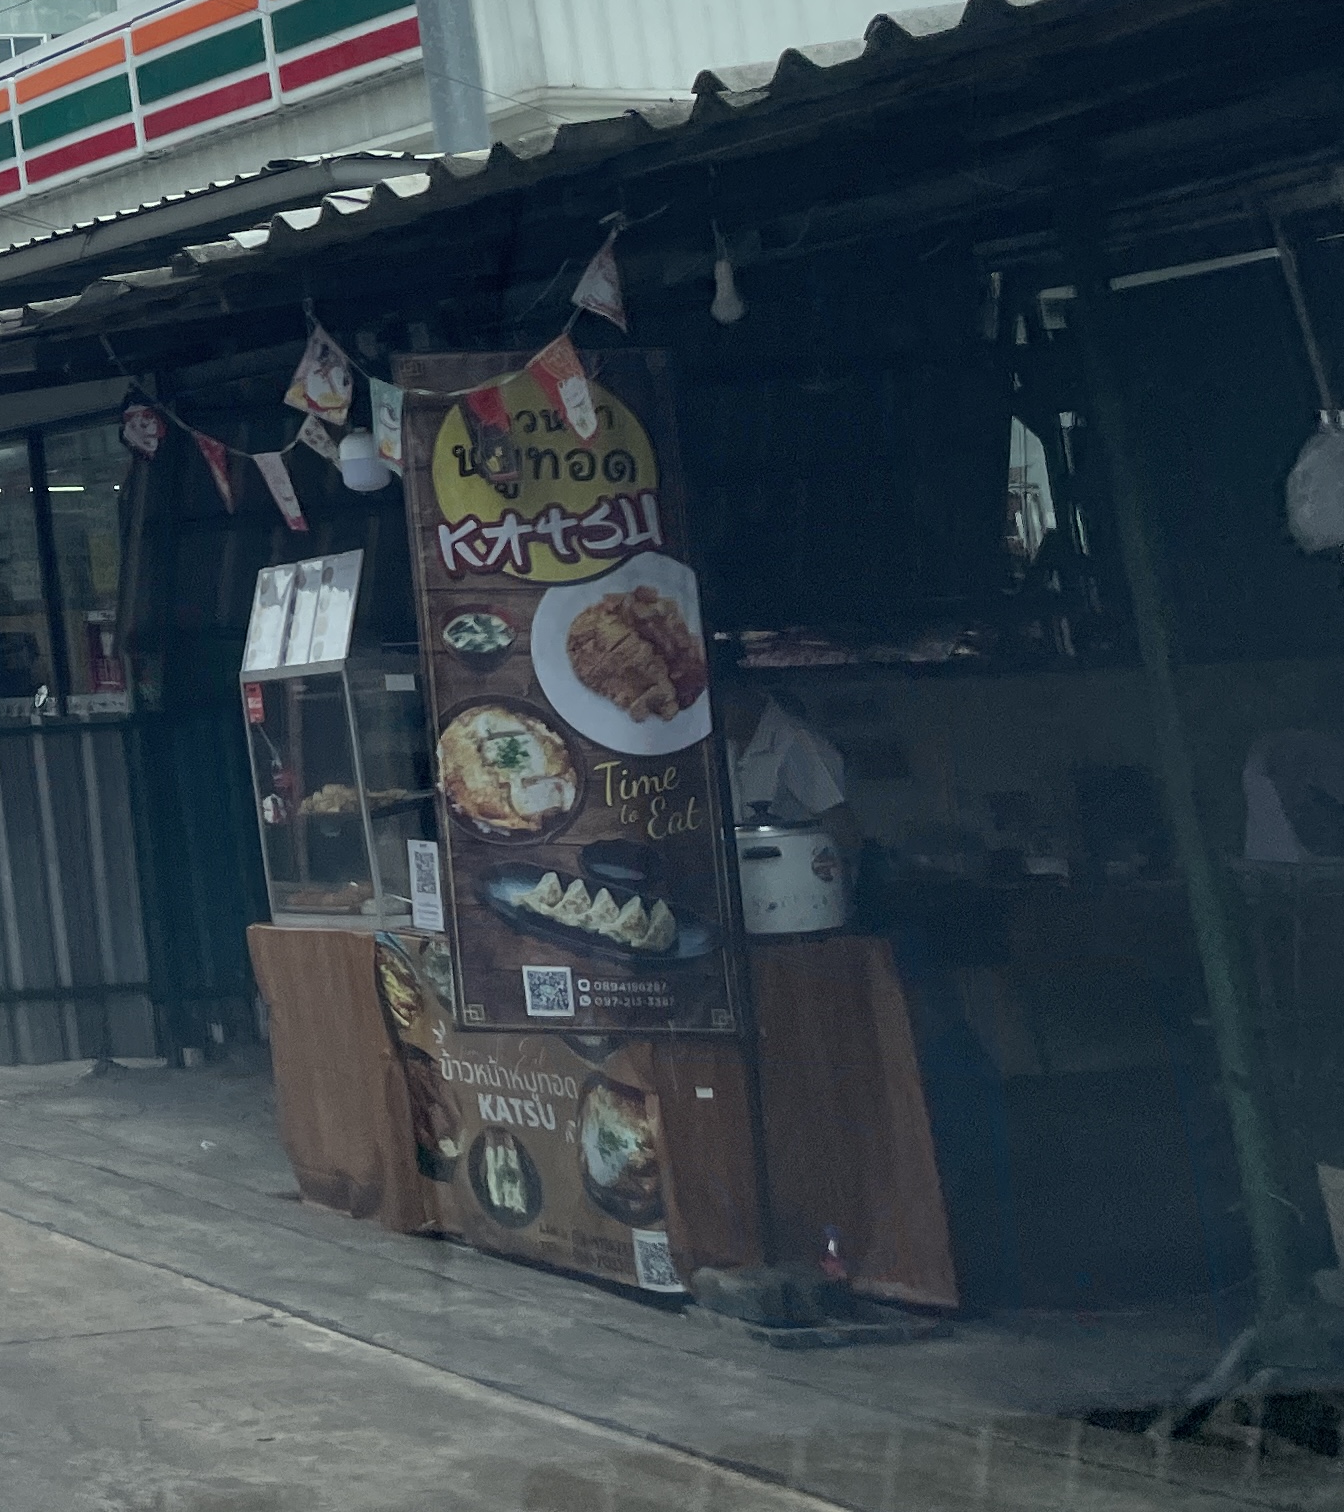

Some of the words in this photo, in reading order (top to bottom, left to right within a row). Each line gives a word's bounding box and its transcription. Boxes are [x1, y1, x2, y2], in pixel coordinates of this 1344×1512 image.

[594, 761, 681, 807] Time
[647, 796, 703, 839] Eat
[439, 1048, 579, 1102] ข้าวหน้าหมูทอด
[477, 1091, 556, 1130] KATSU
